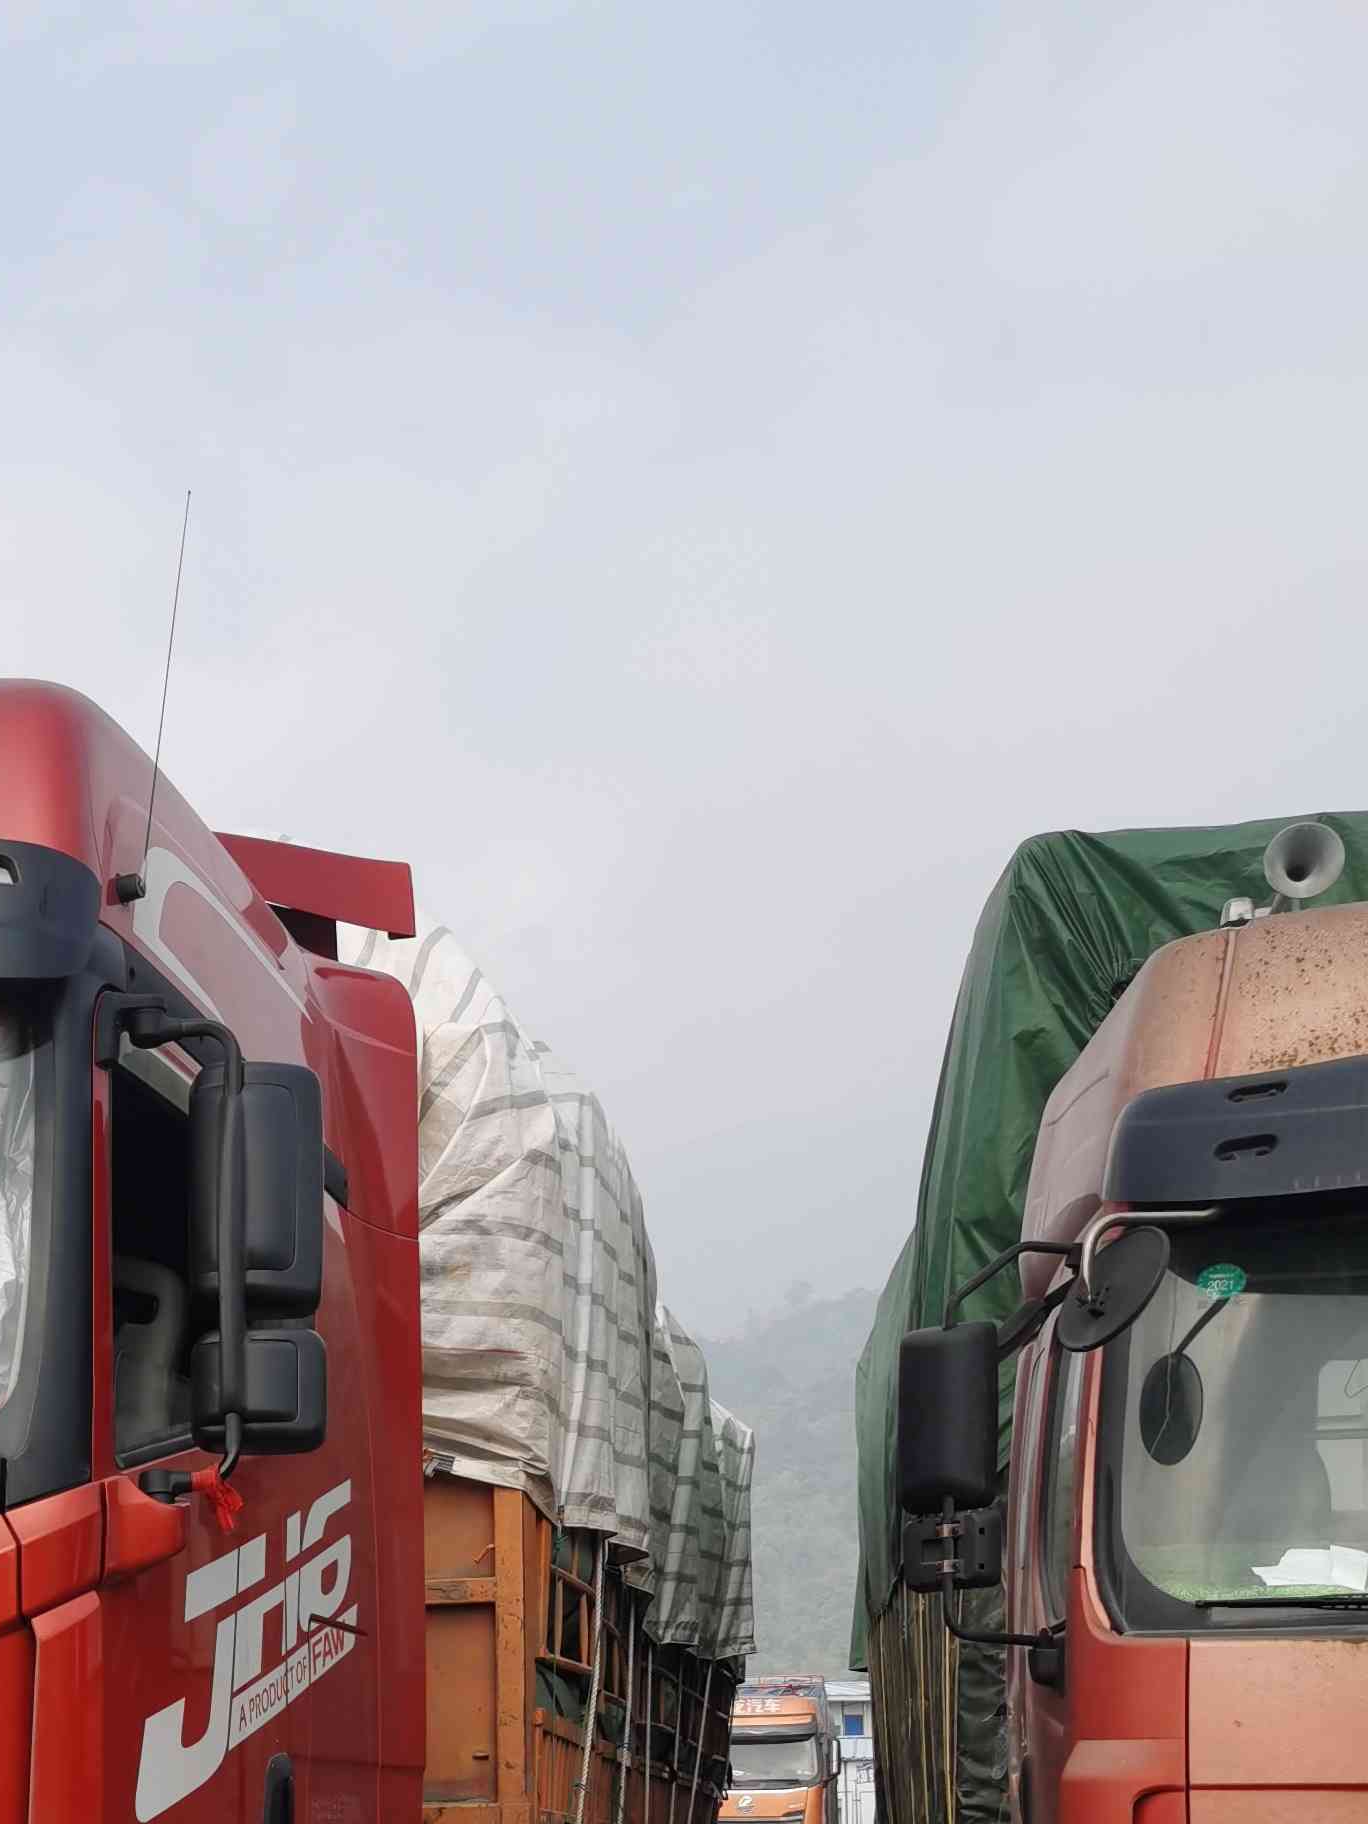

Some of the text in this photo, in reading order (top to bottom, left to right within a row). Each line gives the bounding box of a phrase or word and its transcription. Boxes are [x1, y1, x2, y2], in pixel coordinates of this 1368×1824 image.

[1207, 1279, 1234, 1291] 2021
[239, 1620, 346, 1732] A PRODUCT OF FAW
